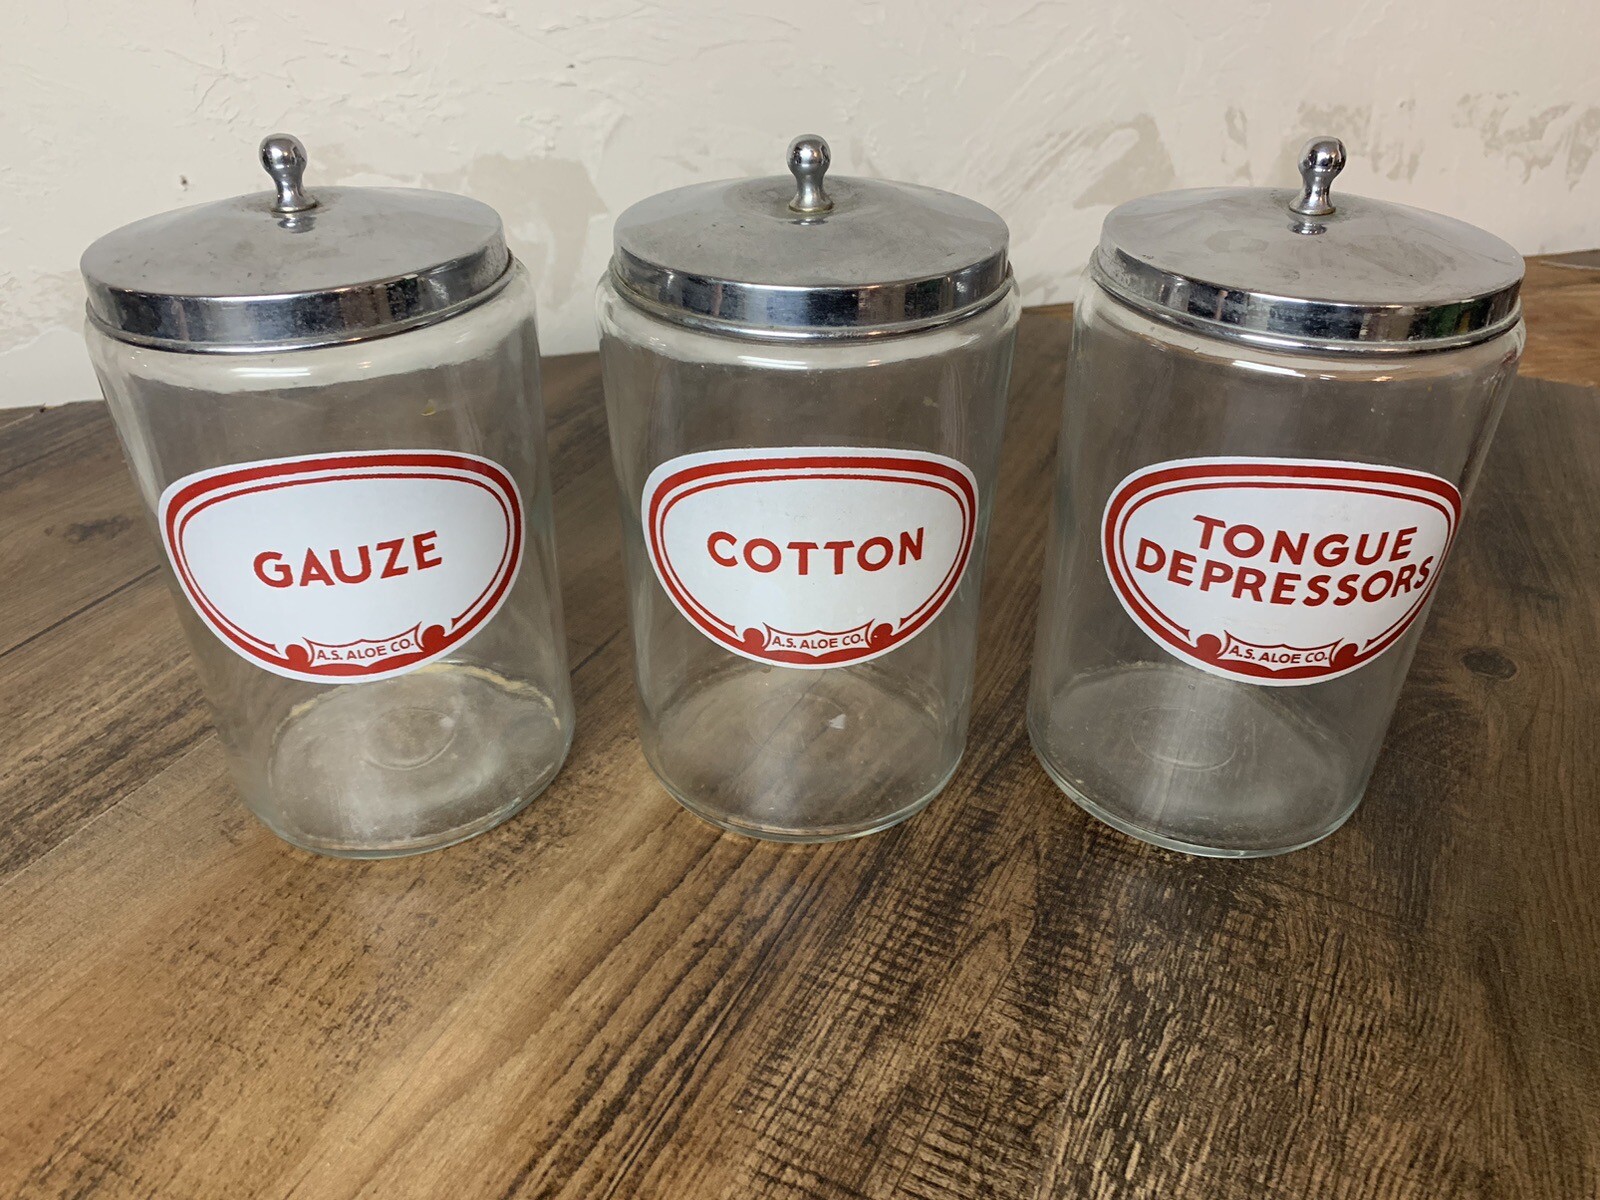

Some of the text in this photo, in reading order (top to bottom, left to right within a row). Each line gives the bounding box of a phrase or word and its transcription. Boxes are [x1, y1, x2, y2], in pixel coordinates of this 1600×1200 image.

[254, 531, 442, 588] GAUZE
[708, 527, 925, 575] COTTON
[1193, 514, 1418, 568] TONGUE
[1135, 537, 1434, 607] DEPRESSORS
[316, 638, 414, 660] A.S. ALOE CO.
[772, 634, 864, 649] A.S. ALOE CO.
[1229, 645, 1328, 664] A.S. ALOE CO.
